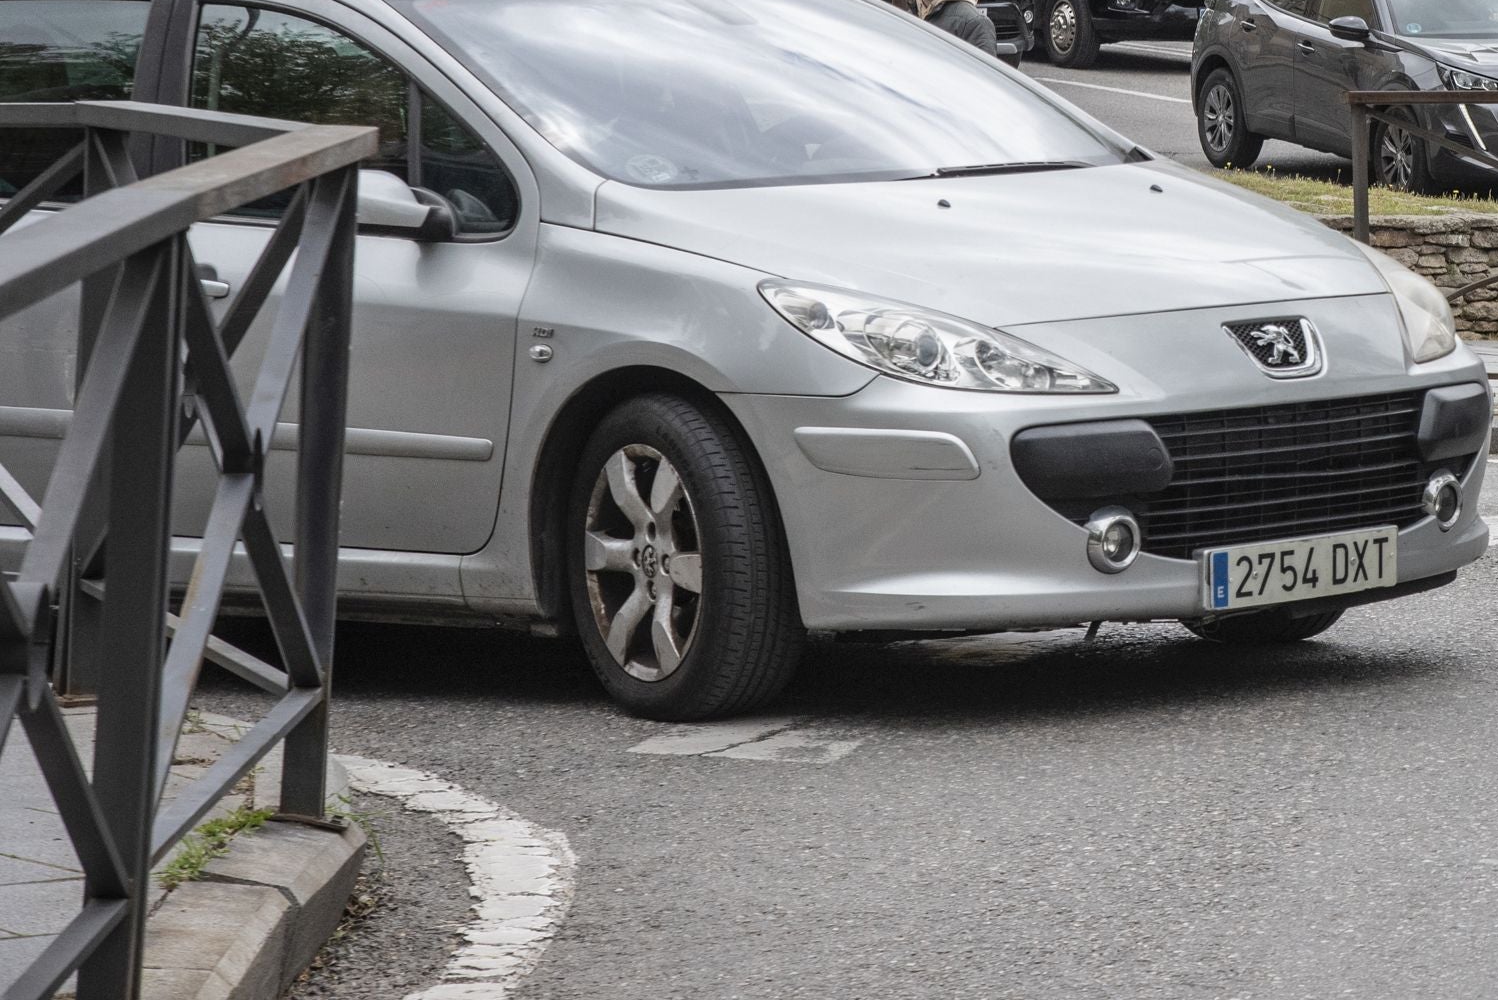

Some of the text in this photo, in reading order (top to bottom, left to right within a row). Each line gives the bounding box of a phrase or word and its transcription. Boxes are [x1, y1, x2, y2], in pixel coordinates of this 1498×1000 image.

[1217, 536, 1389, 599] E 2754 DXT
